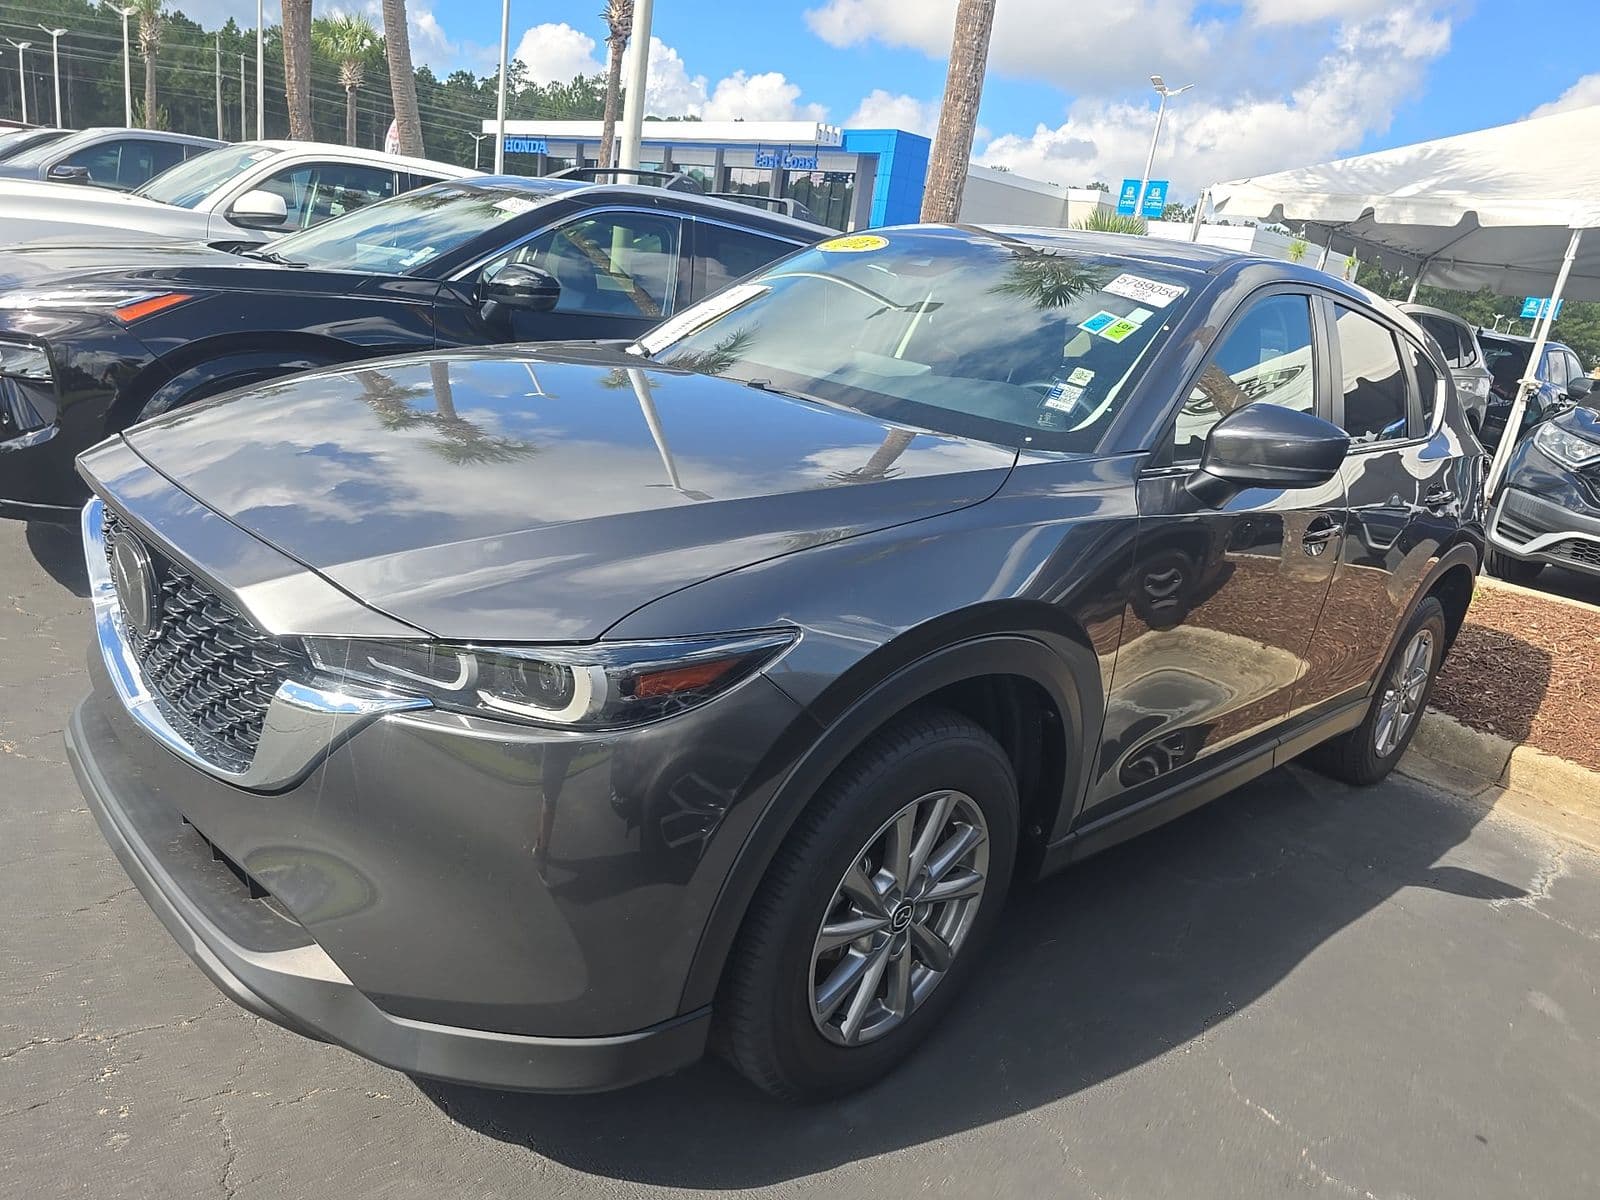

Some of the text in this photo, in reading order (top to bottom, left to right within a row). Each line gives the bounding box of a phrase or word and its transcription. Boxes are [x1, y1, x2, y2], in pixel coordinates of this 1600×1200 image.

[505, 139, 547, 153] HONDA
[755, 150, 818, 170] East Coast
[1116, 276, 1180, 298] 5789050
